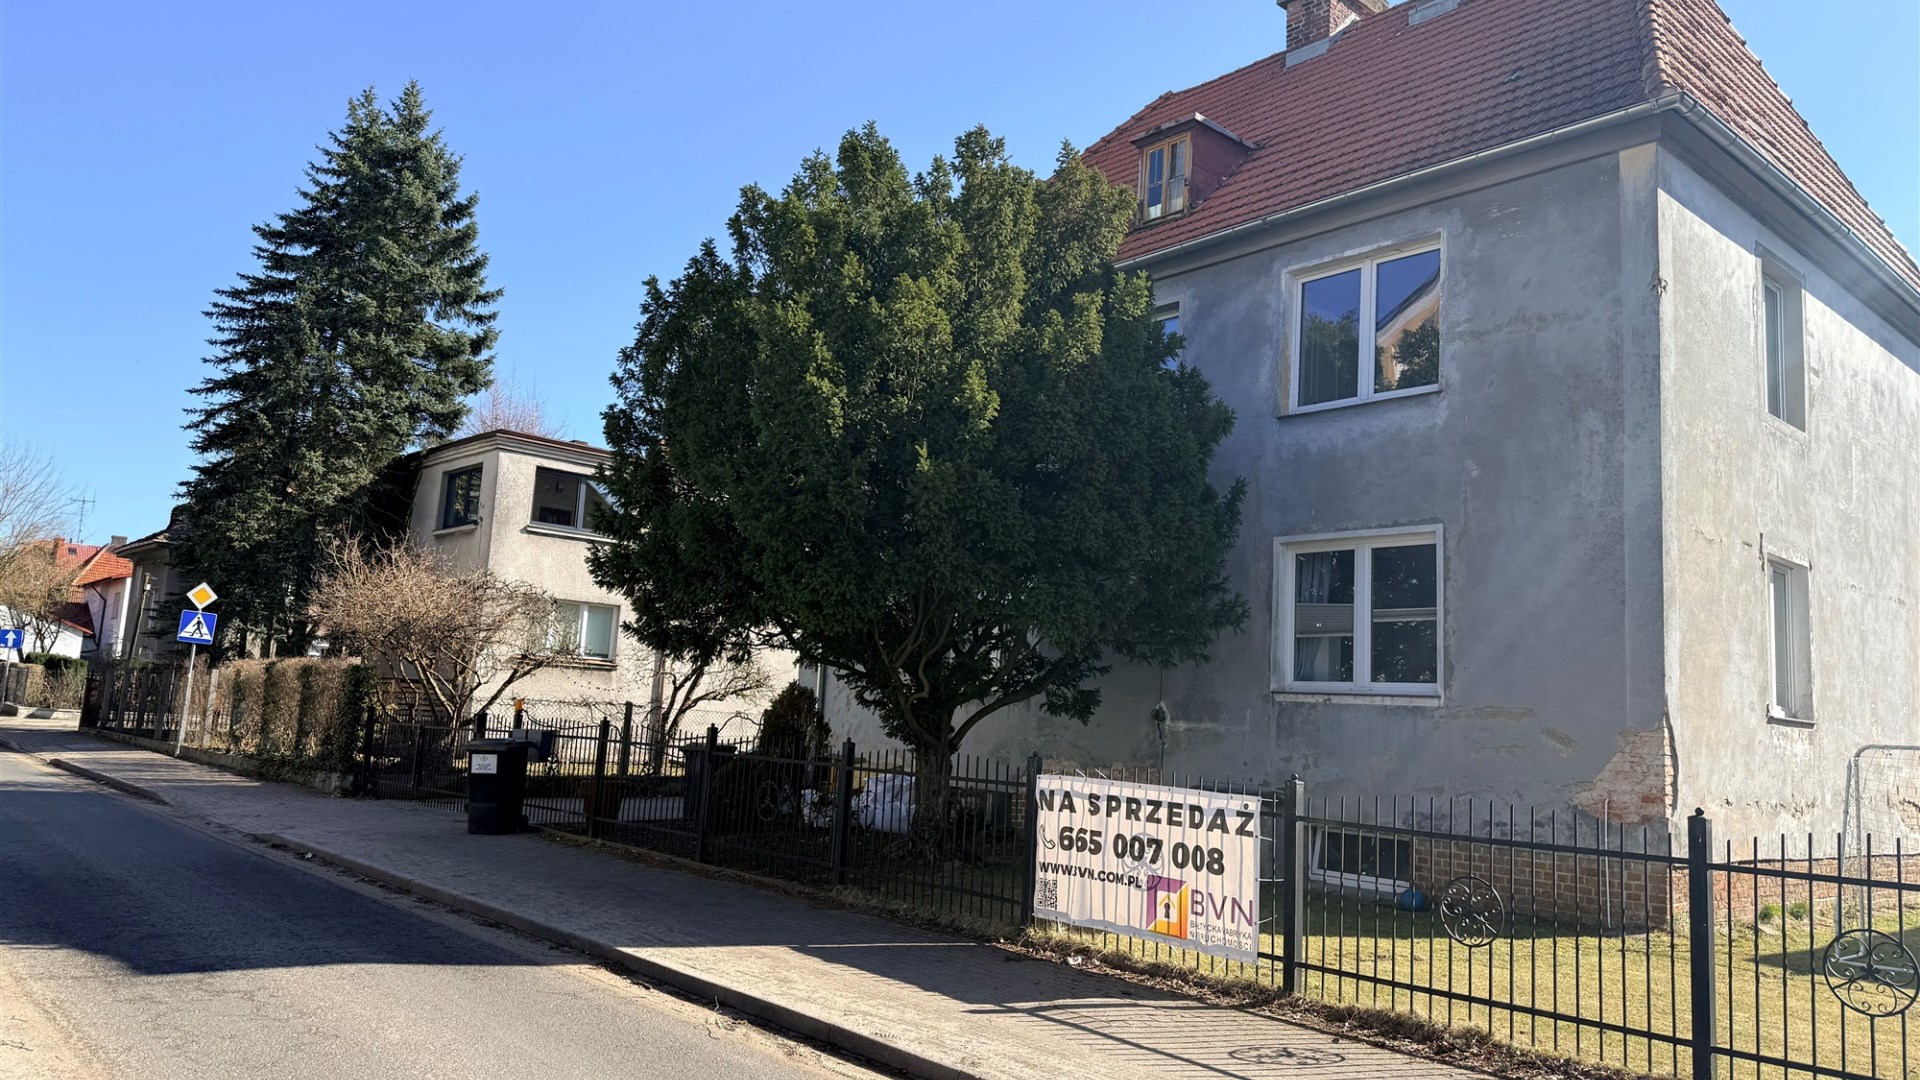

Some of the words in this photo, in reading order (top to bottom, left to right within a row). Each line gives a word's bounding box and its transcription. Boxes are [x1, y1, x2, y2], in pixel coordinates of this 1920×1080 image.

[1039, 789, 1077, 814] NA
[1087, 792, 1255, 838] SPRZEDAŻ
[1059, 826, 1103, 856] 665
[1112, 833, 1164, 865] 007
[1171, 841, 1225, 876] 008
[1039, 861, 1143, 889] WWWVN.COM.PL
[1190, 888, 1254, 928] BVN
[1189, 930, 1253, 952] NERUCHOMOCI
